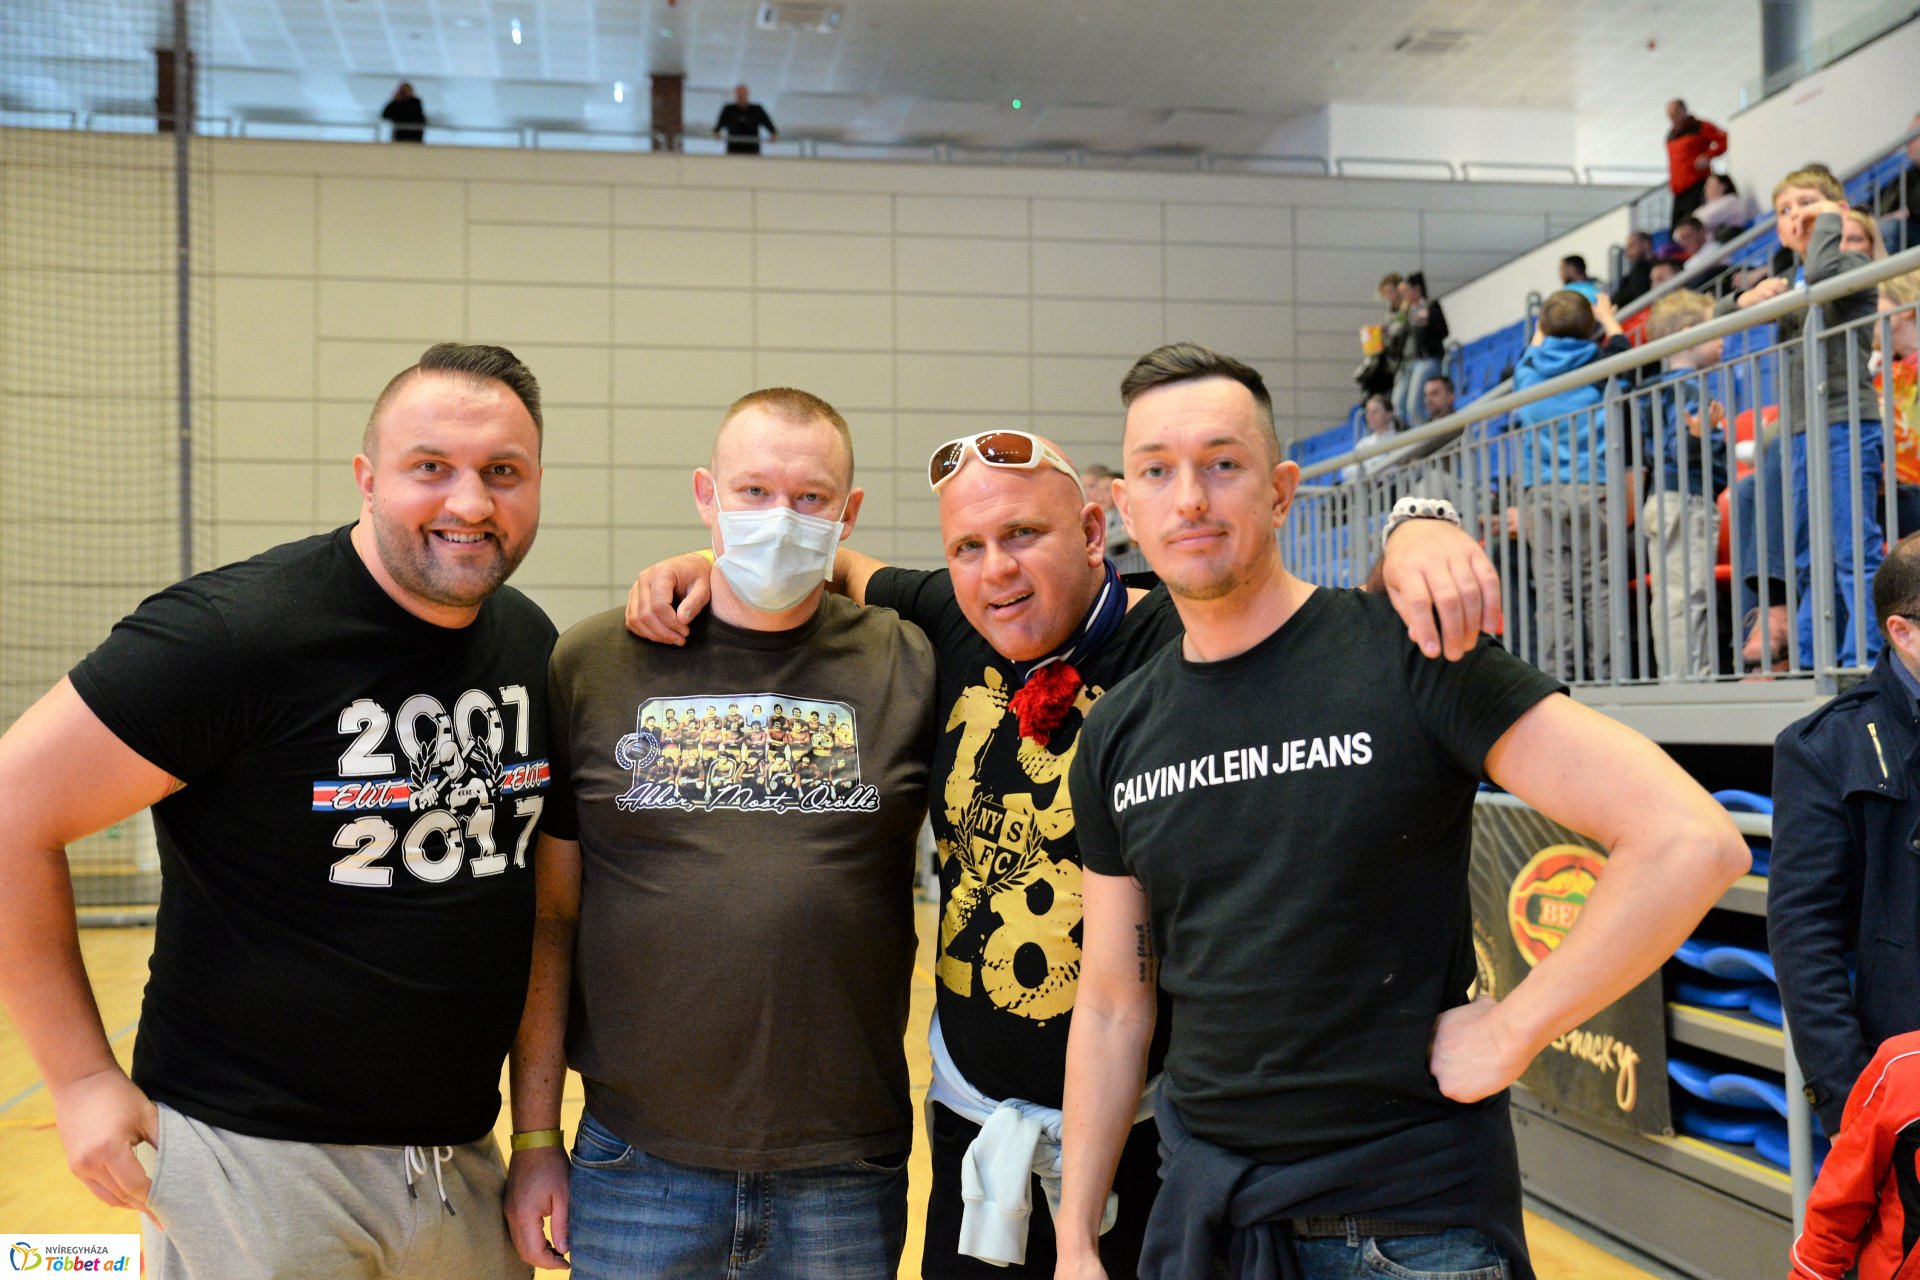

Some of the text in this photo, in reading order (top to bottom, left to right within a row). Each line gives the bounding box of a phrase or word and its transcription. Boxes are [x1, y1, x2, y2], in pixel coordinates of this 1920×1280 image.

[338, 685, 529, 776] 2007
[510, 761, 546, 792] Elit
[1113, 732, 1373, 812] CALVIN KLEIN JEANS
[332, 779, 407, 810] Elit
[708, 784, 794, 810] Most,
[329, 795, 544, 887] 2017
[976, 807, 1023, 842] NY S
[978, 845, 1012, 875] F C
